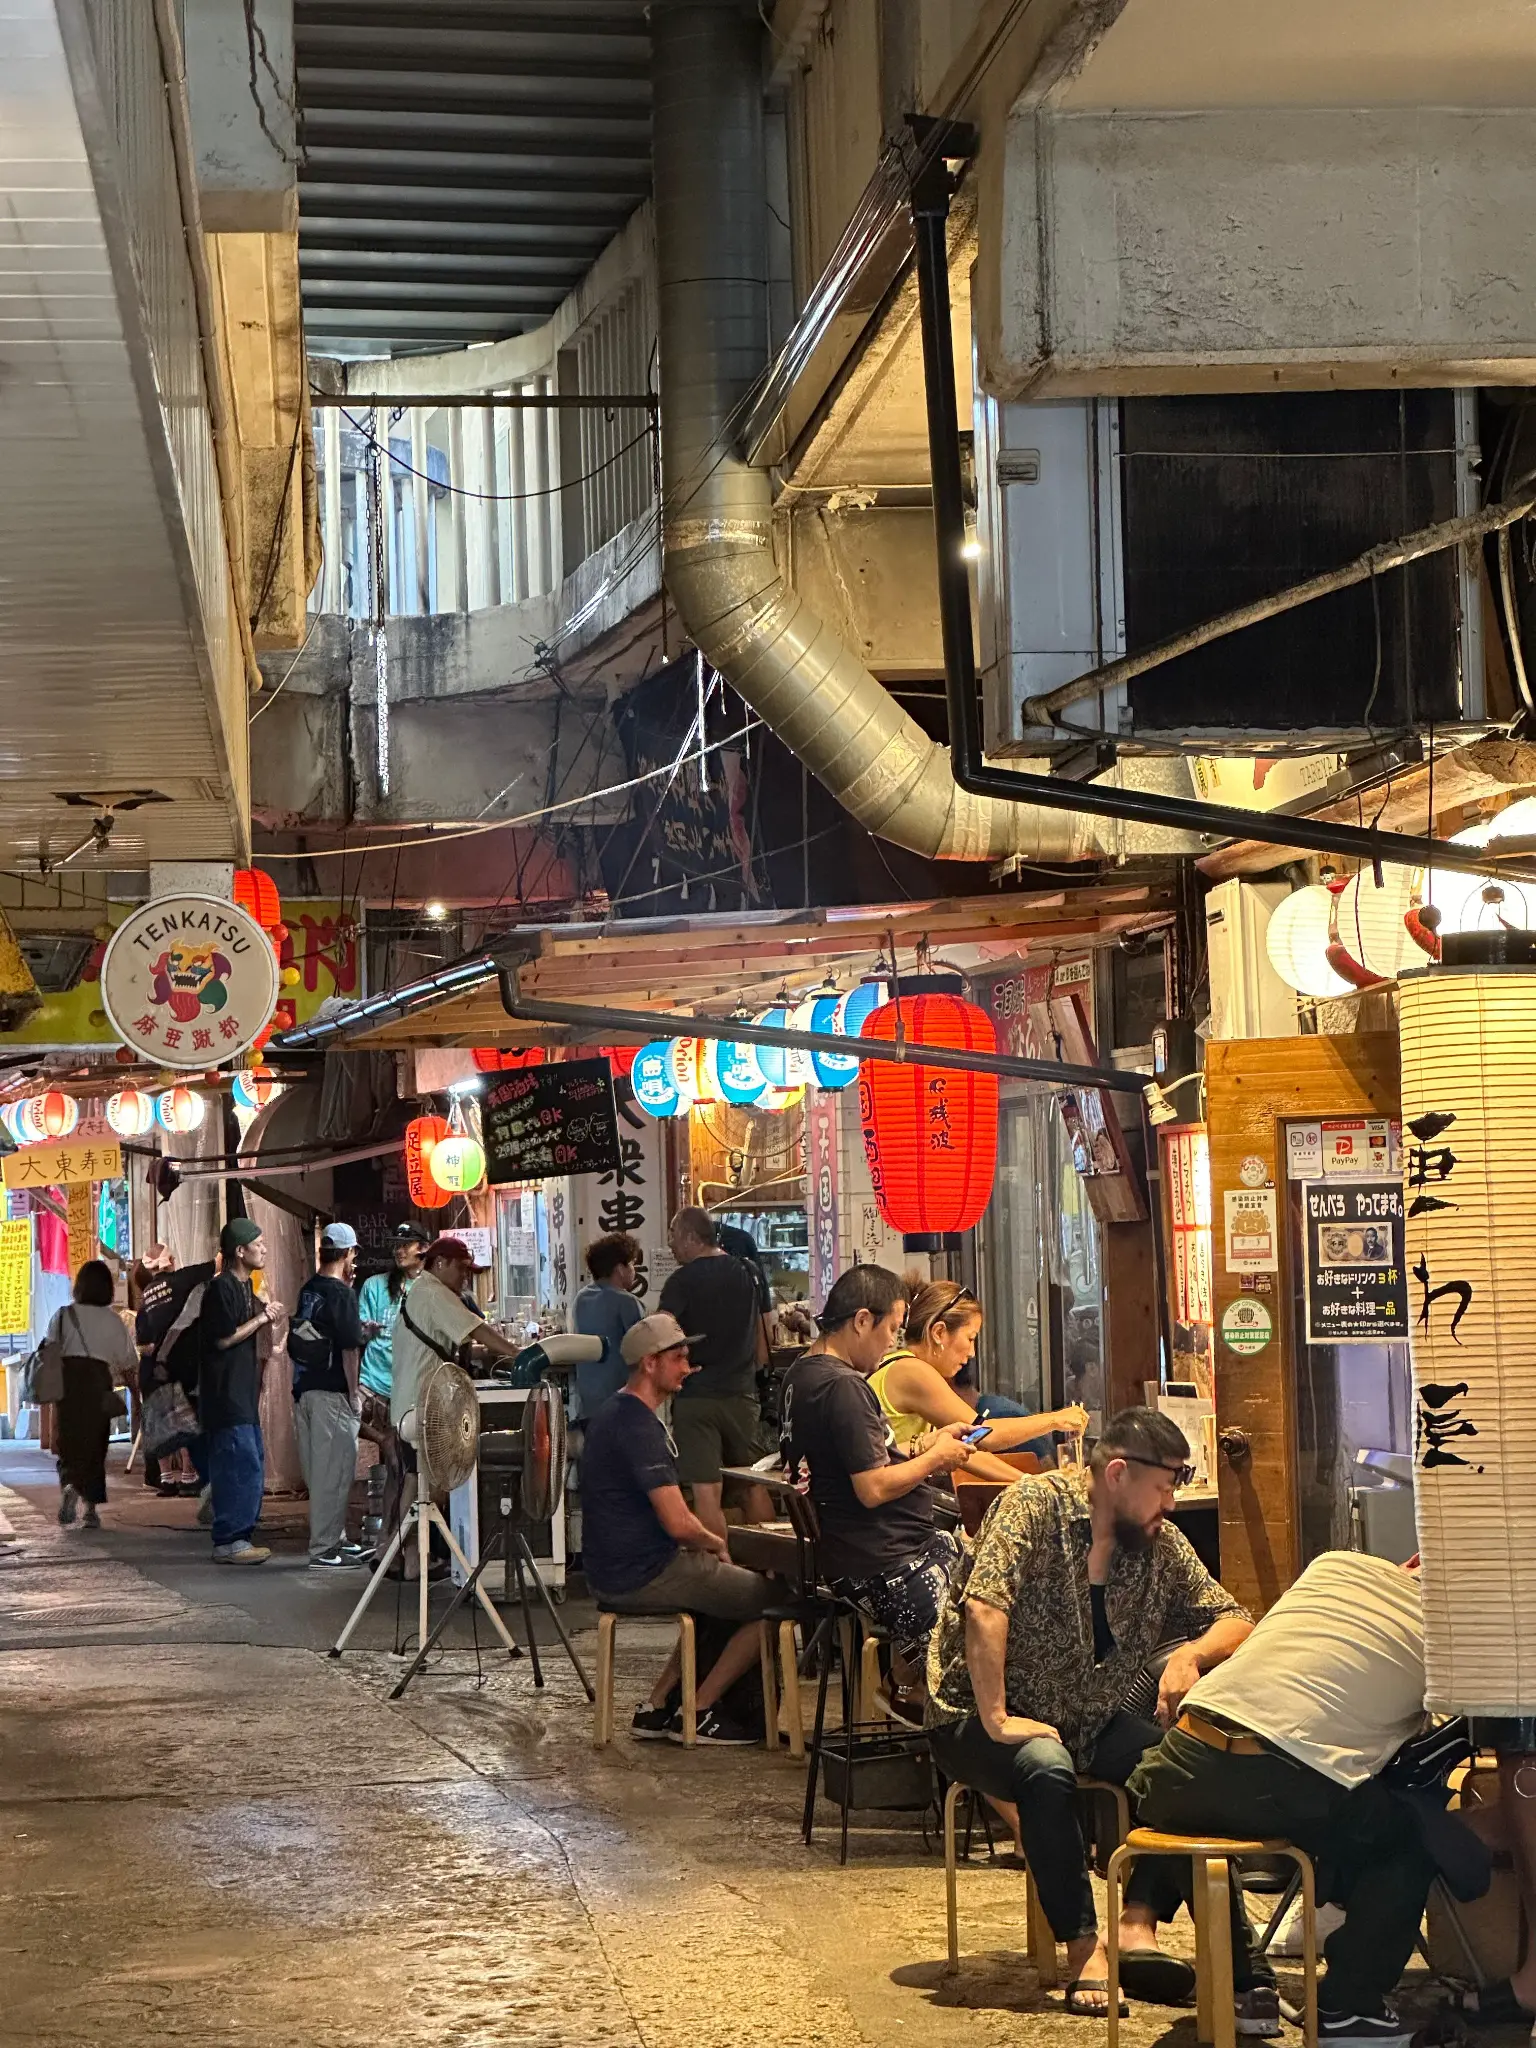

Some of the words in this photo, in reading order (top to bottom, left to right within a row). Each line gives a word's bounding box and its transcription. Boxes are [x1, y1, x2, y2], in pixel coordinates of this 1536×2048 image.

[1299, 756, 1335, 787] TAREYA
[132, 910, 252, 955] TENKATSU
[131, 1013, 240, 1051] 麻亜蹴都
[676, 1037, 693, 1083] Orion
[33, 1099, 44, 1128] Orion
[163, 1095, 174, 1124] Orion
[929, 1101, 955, 1151] 残波
[19, 1148, 118, 1181] 大東寿司
[406, 1130, 426, 1197] 足立屋
[1331, 1156, 1359, 1166] PayPay
[1309, 1194, 1346, 1218] せんべろ
[1355, 1192, 1404, 1218] やってます。
[358, 1213, 388, 1229] BAR
[1322, 1301, 1396, 1317] お好きな料理一品
